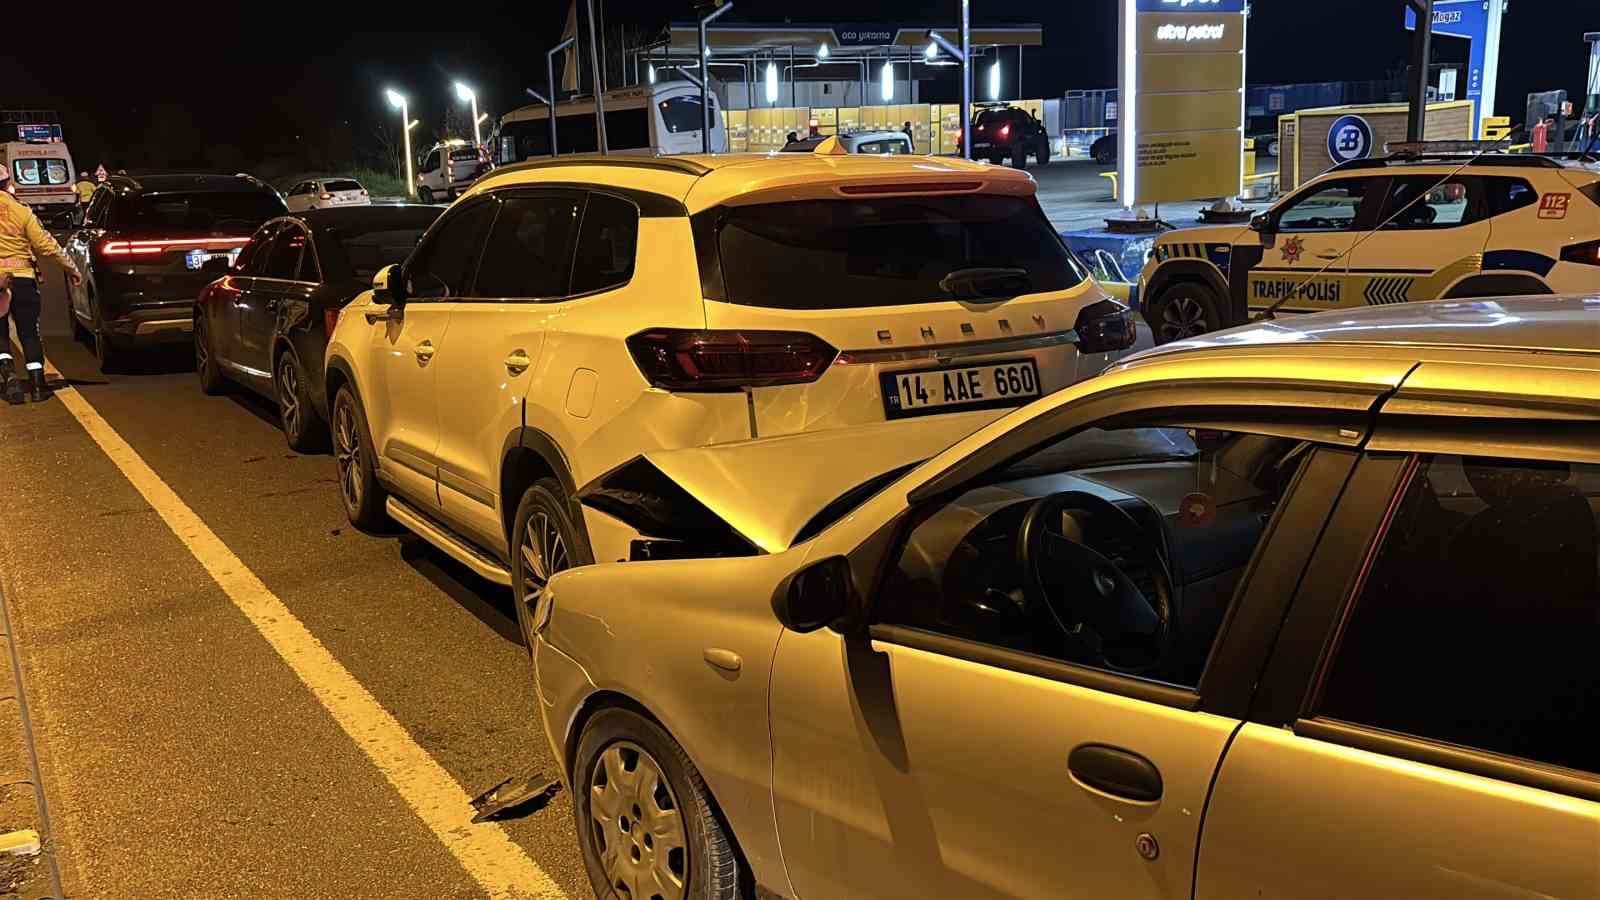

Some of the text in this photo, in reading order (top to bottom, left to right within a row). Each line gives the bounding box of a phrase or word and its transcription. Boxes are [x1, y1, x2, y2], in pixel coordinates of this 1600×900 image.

[1157, 24, 1225, 42] ultra petrol
[1545, 194, 1566, 208] 112
[1252, 277, 1341, 302] TRAFİK POLİSİ
[876, 314, 1046, 341] CHERY
[902, 376, 928, 406] 14
[944, 370, 983, 402] AAE
[993, 365, 1034, 396] 660
